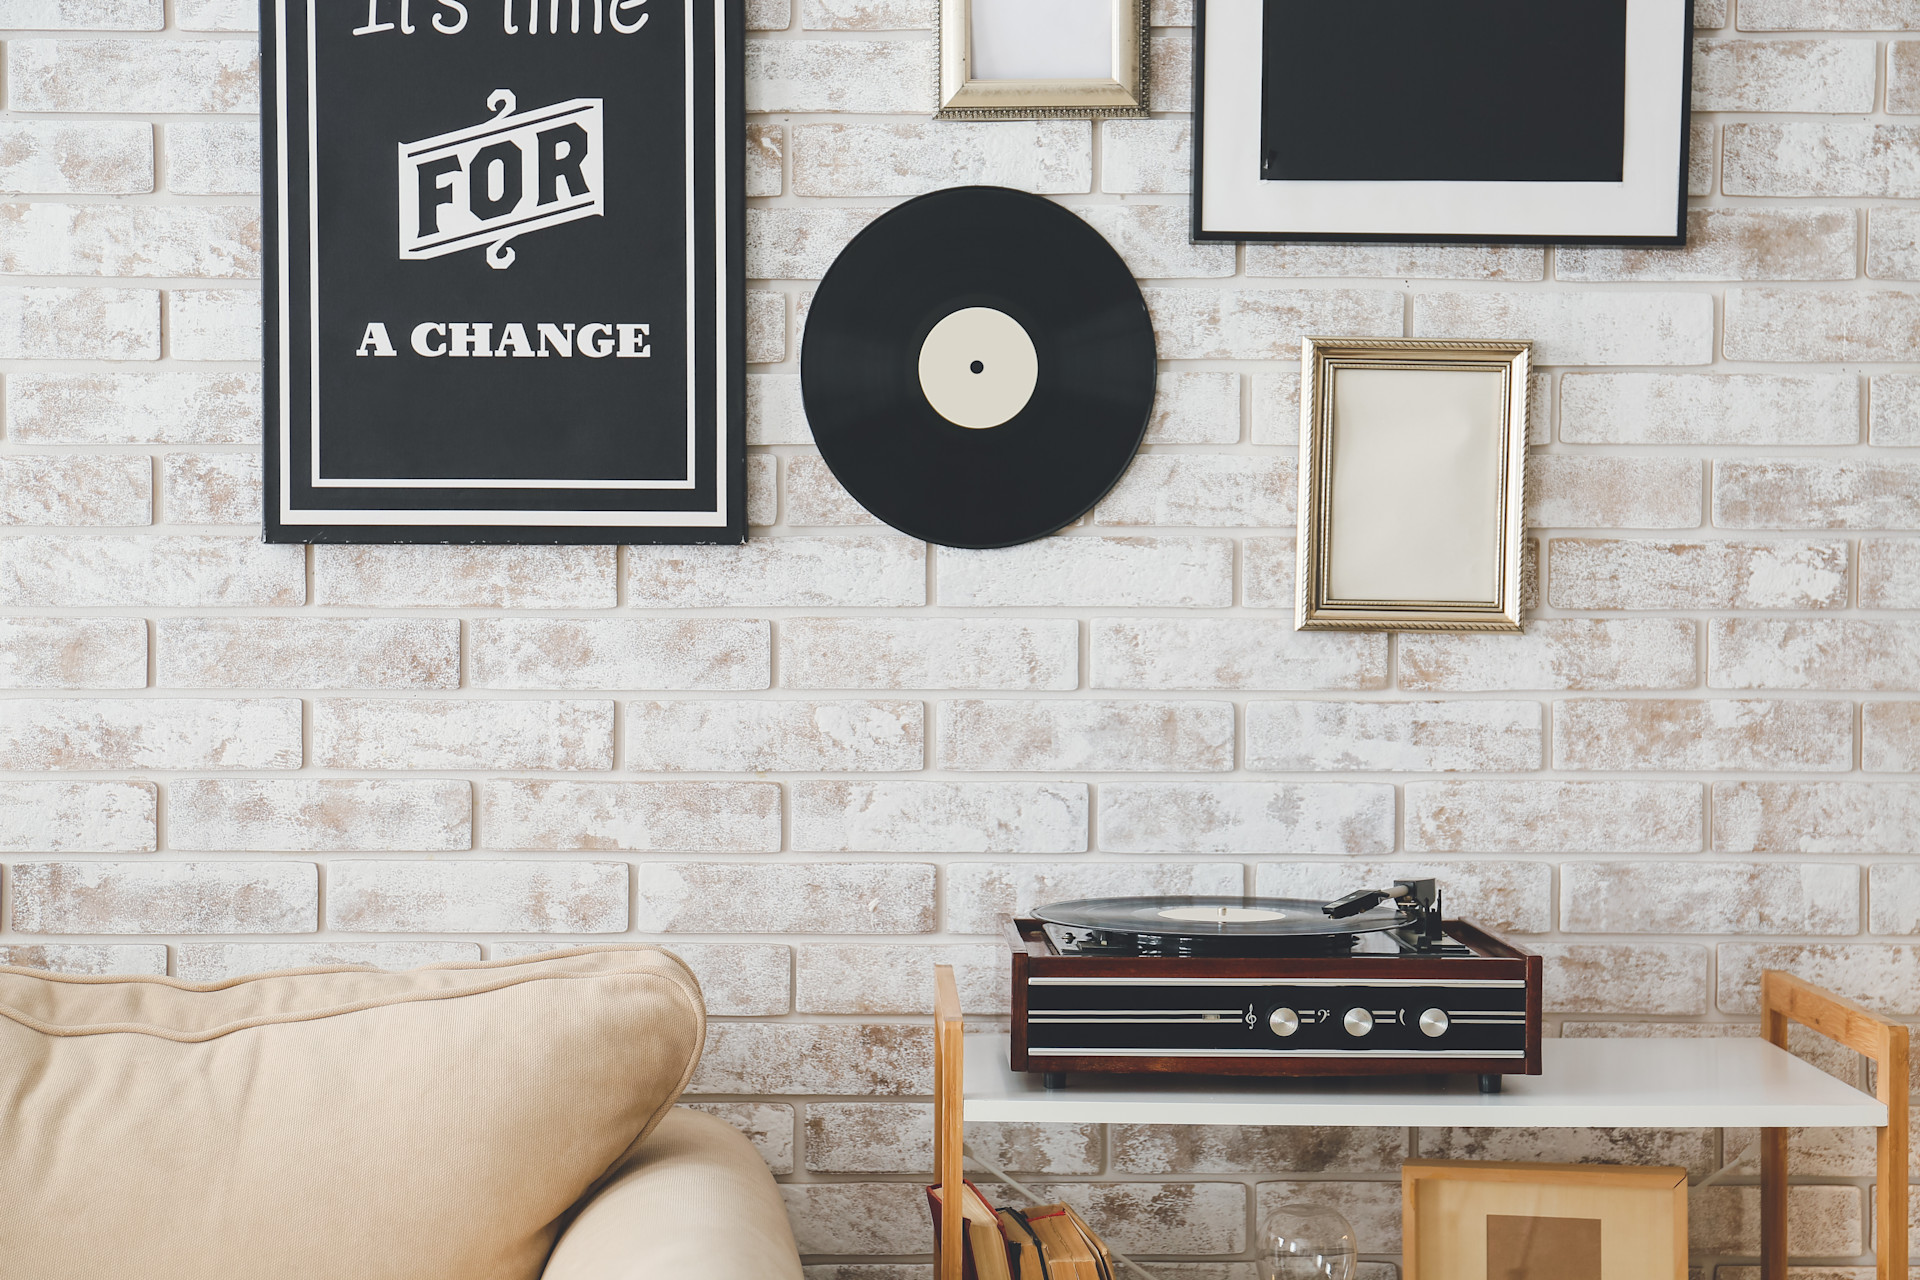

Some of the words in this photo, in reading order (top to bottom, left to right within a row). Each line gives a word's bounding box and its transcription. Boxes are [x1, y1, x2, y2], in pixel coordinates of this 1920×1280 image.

[417, 122, 591, 239] FOR
[355, 322, 398, 358] A
[410, 321, 651, 358] CHANGE
